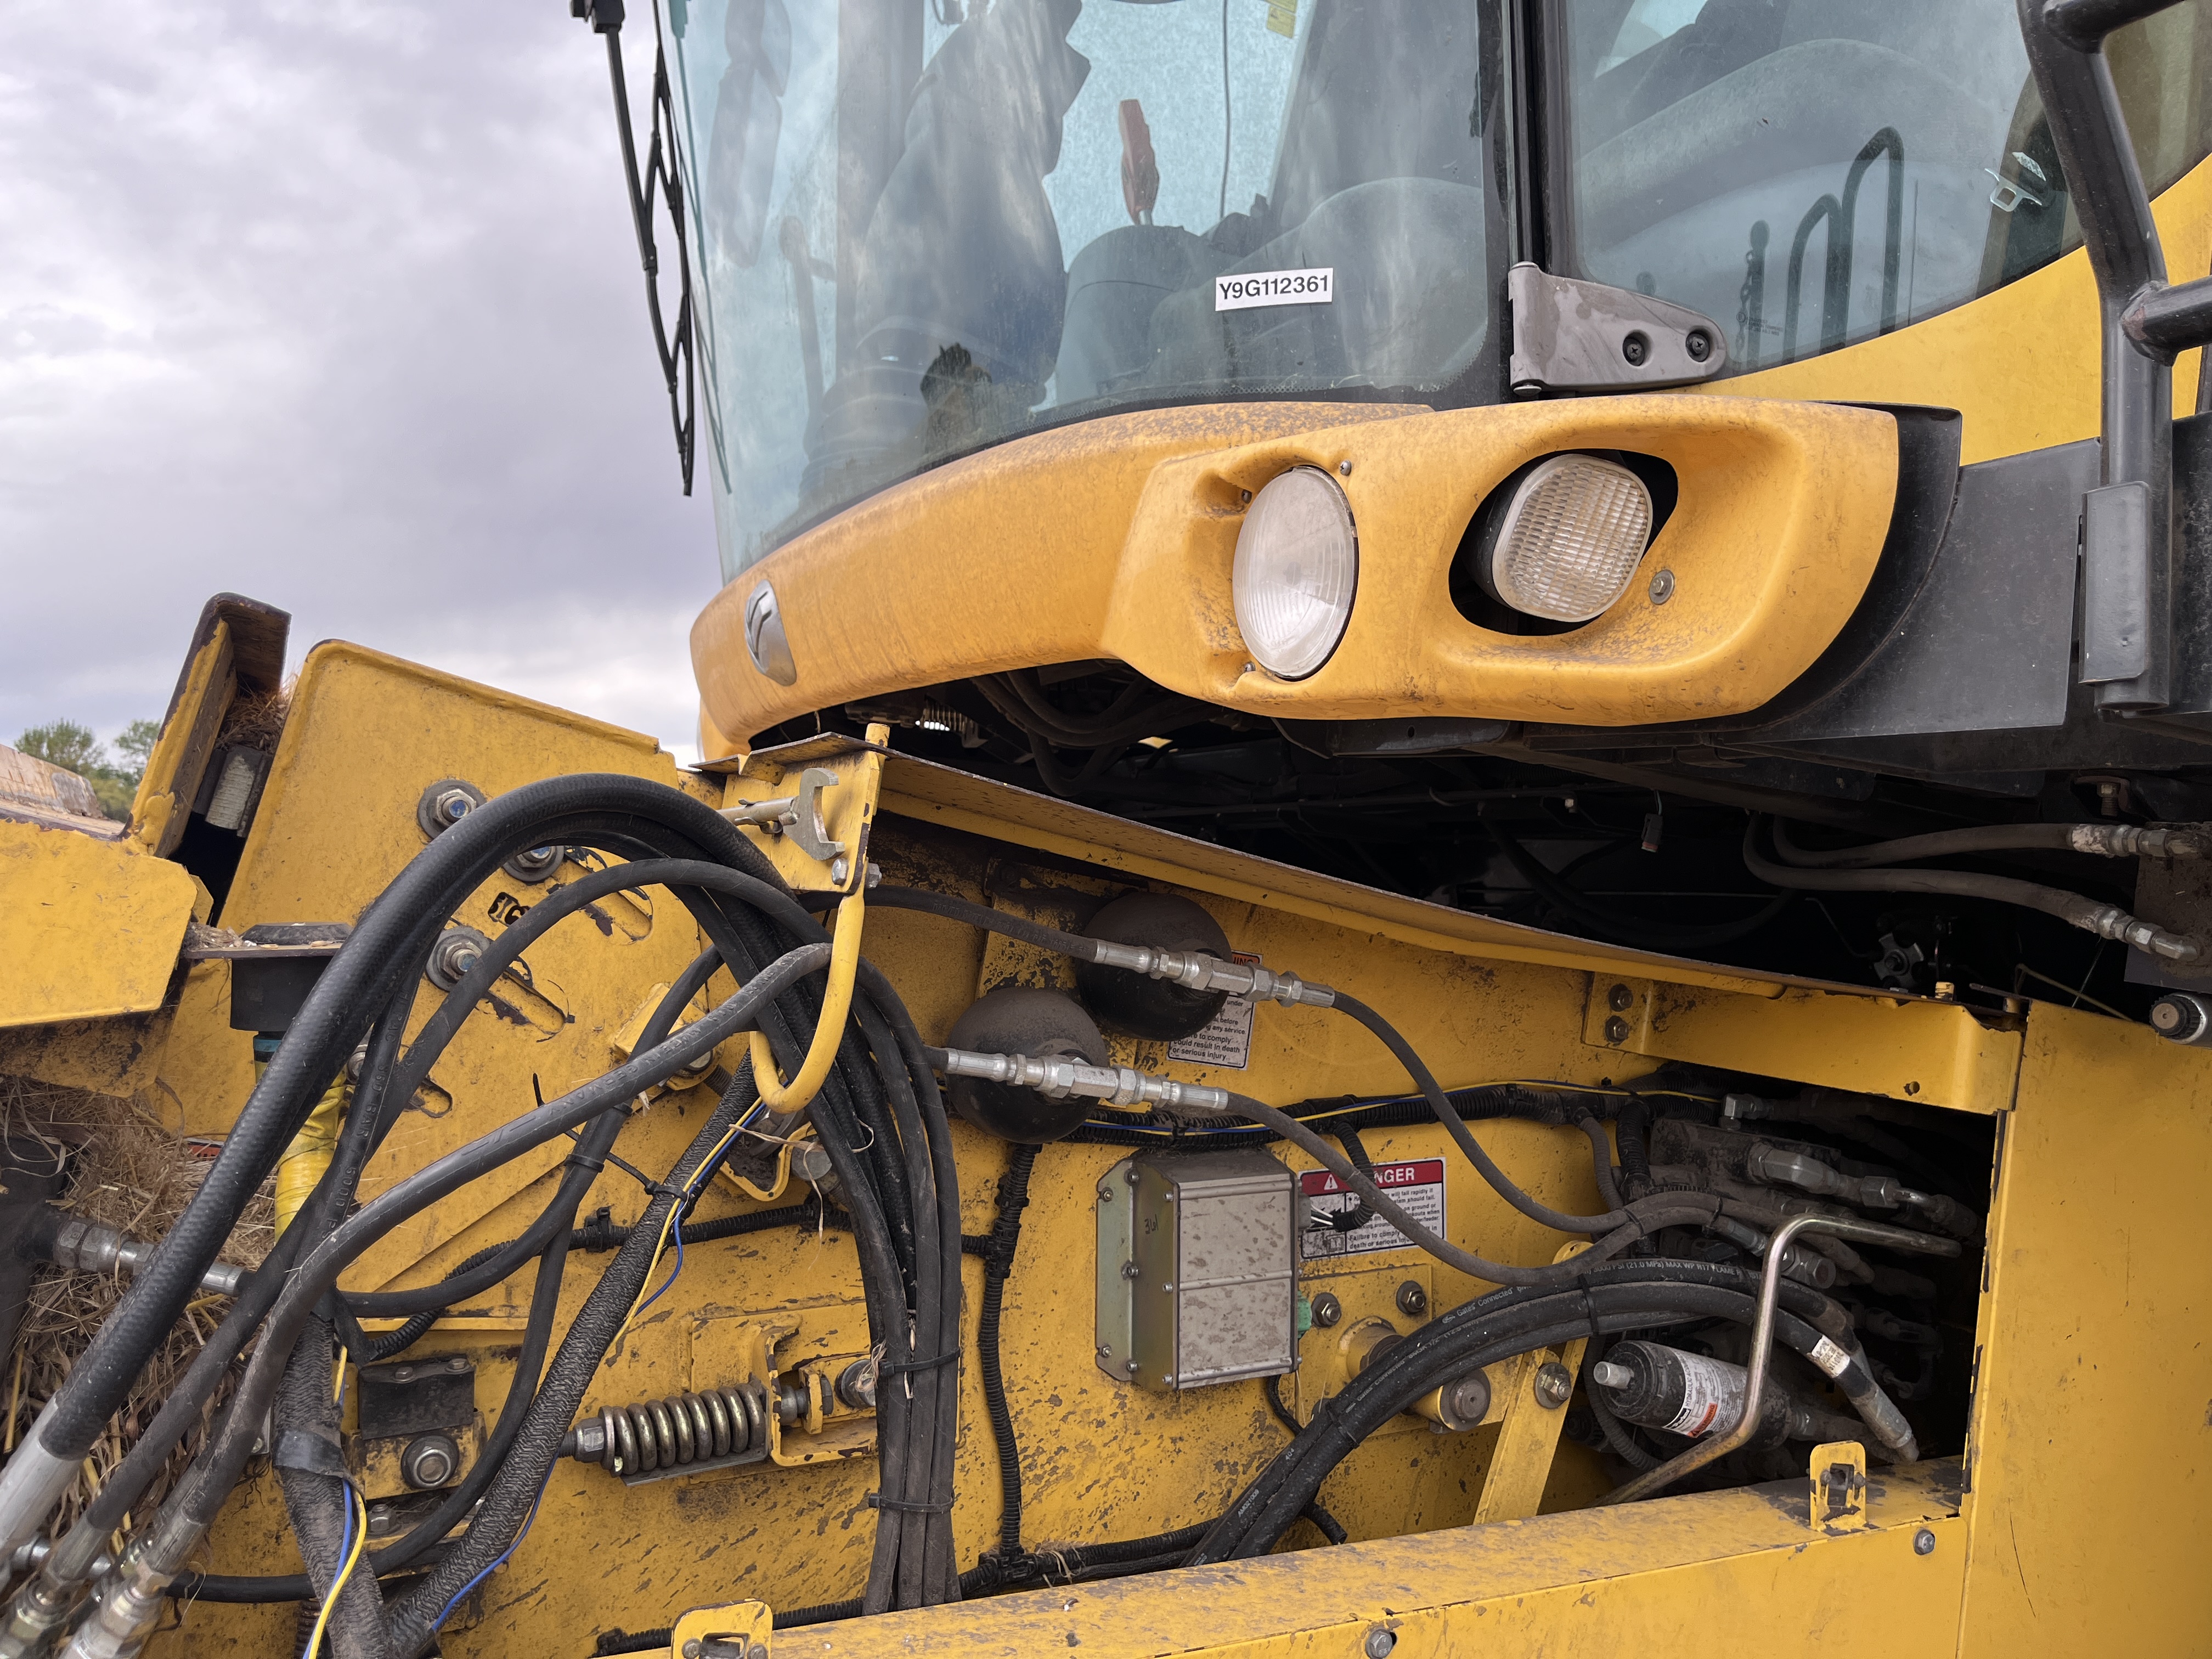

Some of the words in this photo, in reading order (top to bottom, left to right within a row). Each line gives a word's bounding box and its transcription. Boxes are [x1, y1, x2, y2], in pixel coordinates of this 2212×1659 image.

[1218, 275, 1328, 300] Y9G112361
[1220, 1016, 1239, 1025] before
[659, 1025, 703, 1053] MADE
[1224, 1027, 1246, 1035] service.
[1207, 1035, 1232, 1045] comply
[1181, 1048, 1206, 1057] serious
[1207, 1051, 1227, 1061] injury
[1222, 1045, 1240, 1053] death
[641, 1049, 661, 1067] IN
[549, 1063, 638, 1117] GERMANY
[356, 1103, 377, 1138] BAR
[1374, 1167, 1415, 1183] NGER
[336, 1166, 357, 1207] 5000
[1412, 1203, 1430, 1211] ground
[1144, 1214, 1159, 1234] 361
[1379, 1229, 1400, 1238] comply
[1350, 1241, 1367, 1249] death
[1612, 1263, 1625, 1272] PSI
[1627, 1261, 1645, 1270] (21.0
[1646, 1261, 1664, 1269] MPa)
[1457, 1302, 1476, 1317] Gates
[1477, 1287, 1513, 1306] Connected
[1357, 1386, 1374, 1402] Gates
[1374, 1360, 1406, 1386] Connected
[1685, 1376, 1694, 1407] HYDRAULIC
[1285, 1448, 1295, 1460] 404
